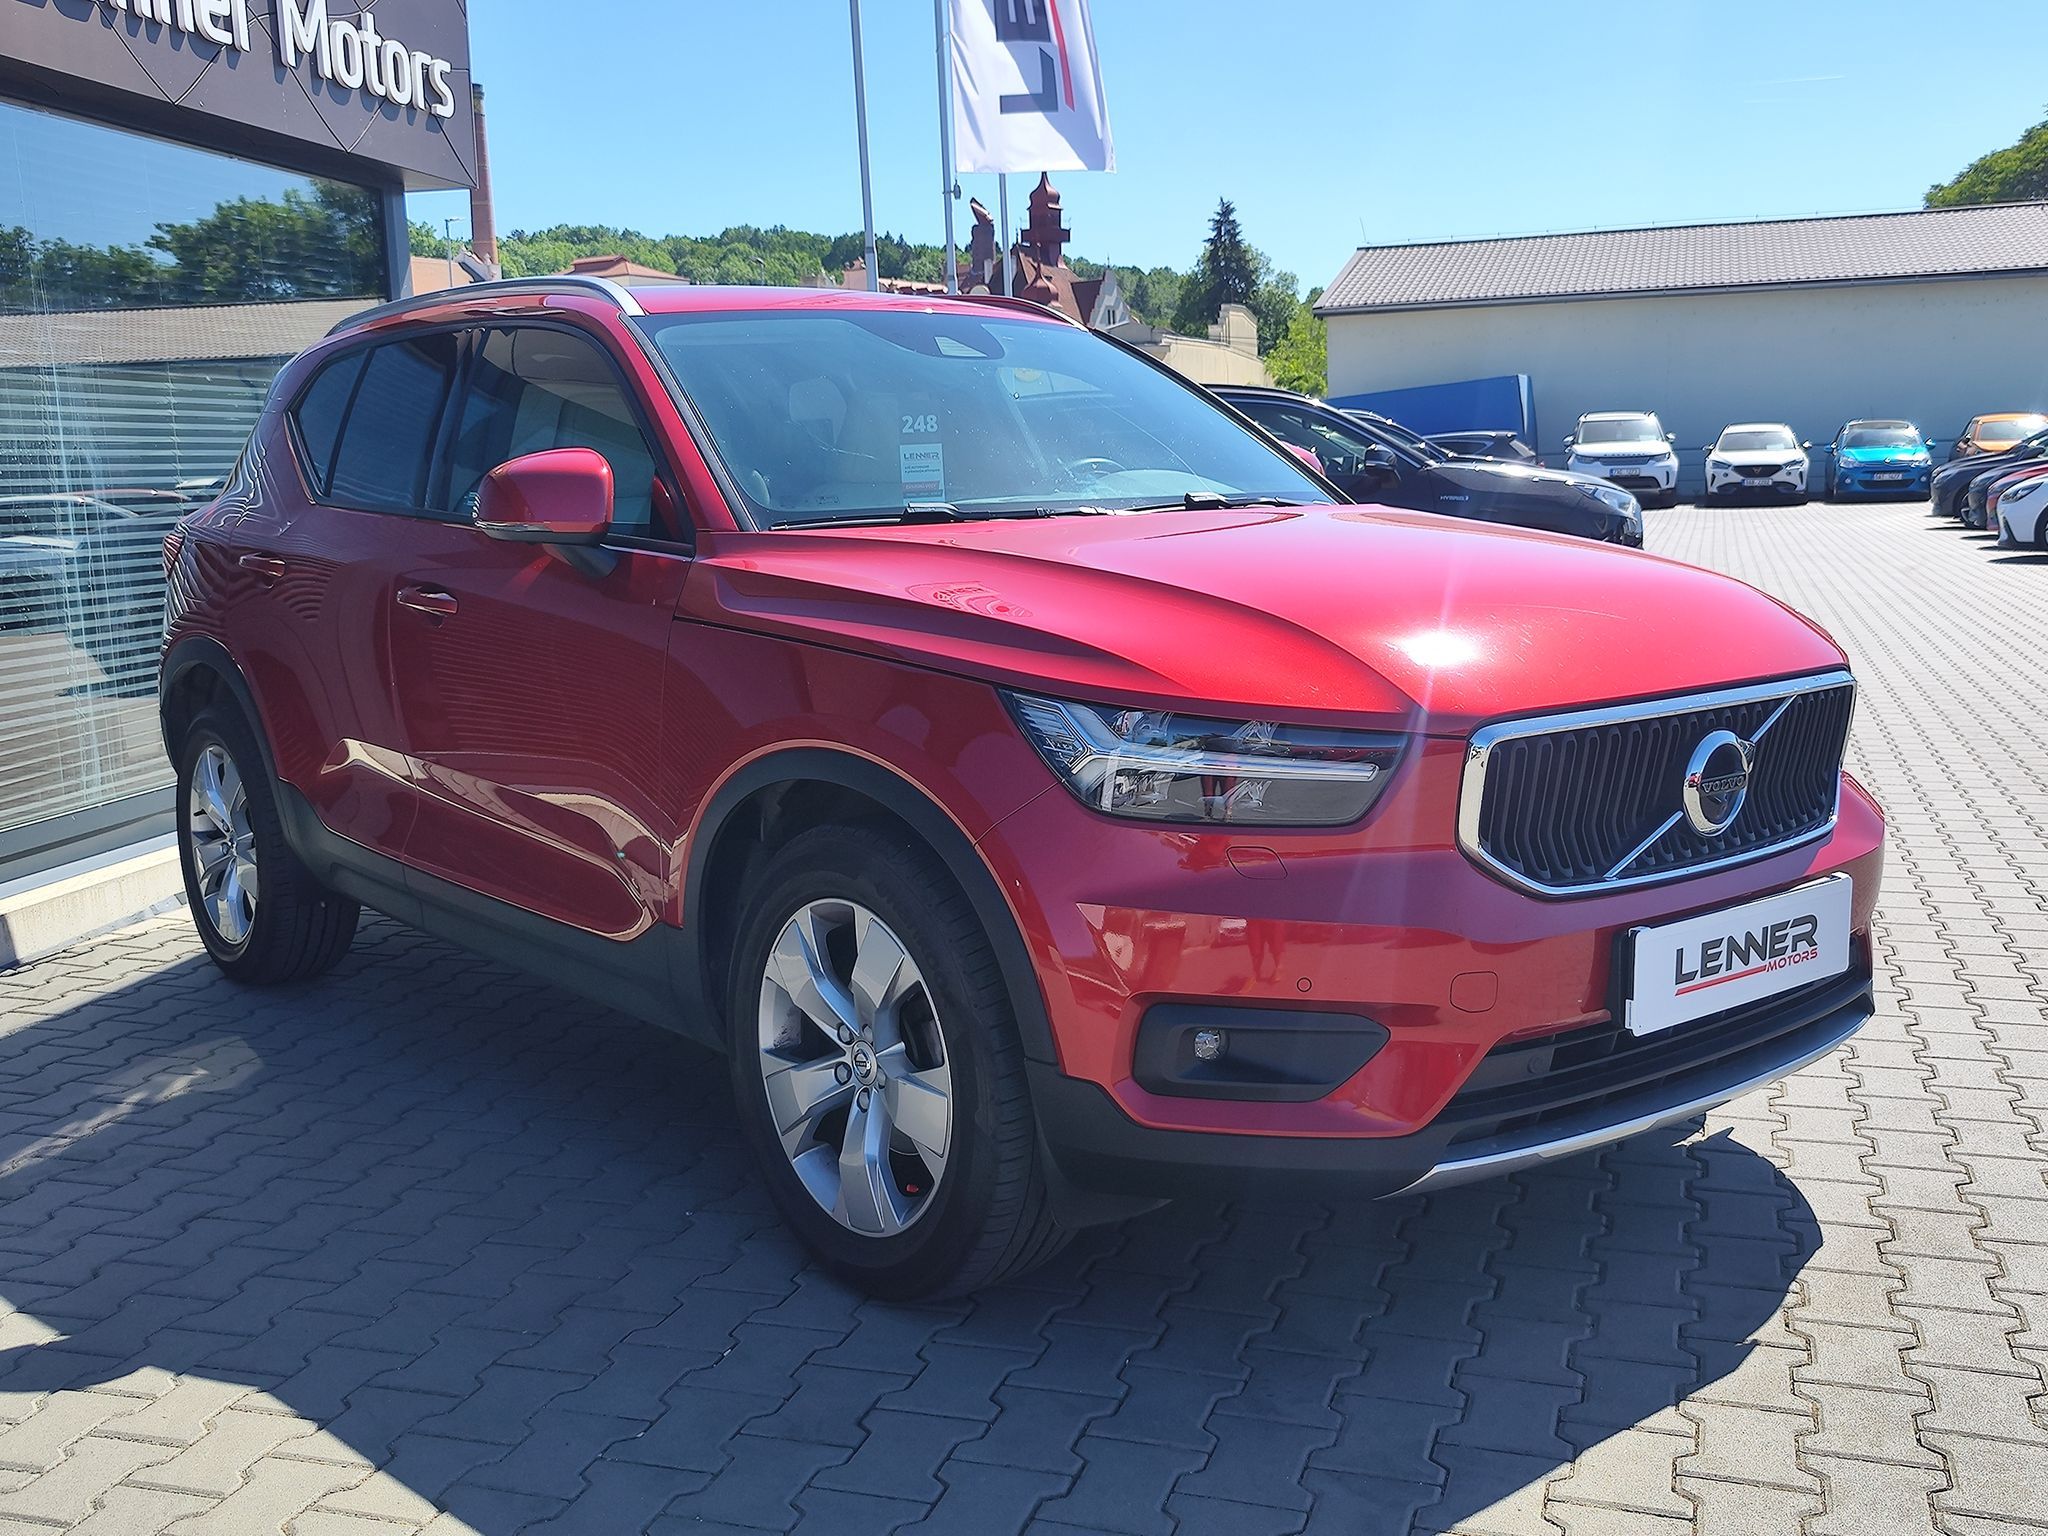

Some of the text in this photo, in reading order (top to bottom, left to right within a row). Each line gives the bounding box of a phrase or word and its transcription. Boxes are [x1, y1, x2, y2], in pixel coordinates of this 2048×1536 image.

[278, 0, 456, 119] Motors
[902, 415, 938, 433] 248
[1701, 775, 1745, 793] VOLVO
[1675, 914, 1818, 985] LENNER
[1766, 948, 1818, 972] MOTORS
